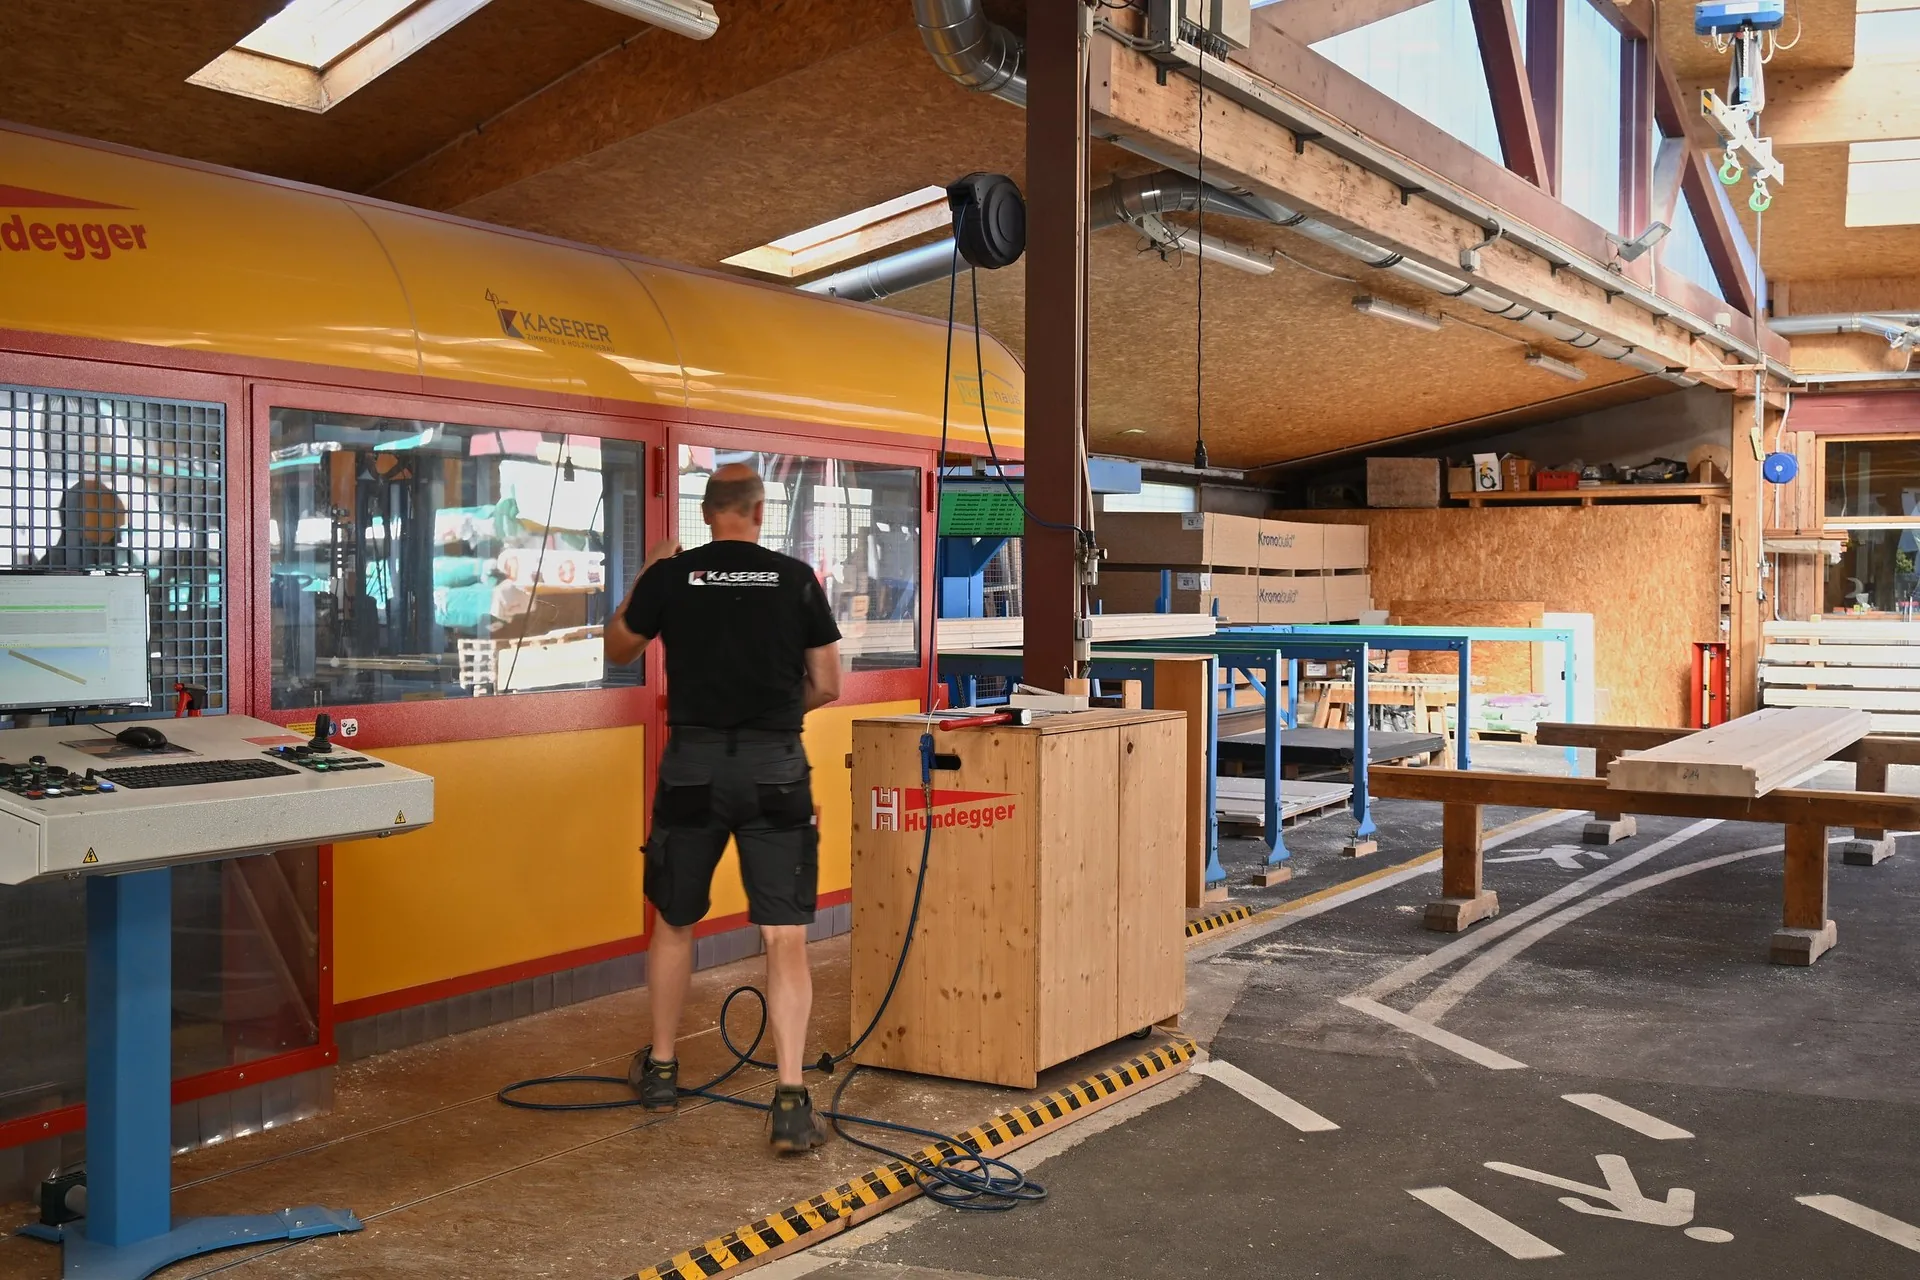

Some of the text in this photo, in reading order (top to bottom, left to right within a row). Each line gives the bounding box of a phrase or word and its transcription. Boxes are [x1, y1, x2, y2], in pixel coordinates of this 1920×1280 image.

[0, 214, 147, 261] degger
[520, 311, 613, 343] KASERER
[526, 333, 560, 345] ZIMMEREI
[706, 570, 780, 583] KASERER
[904, 804, 1016, 832] Hundegger
